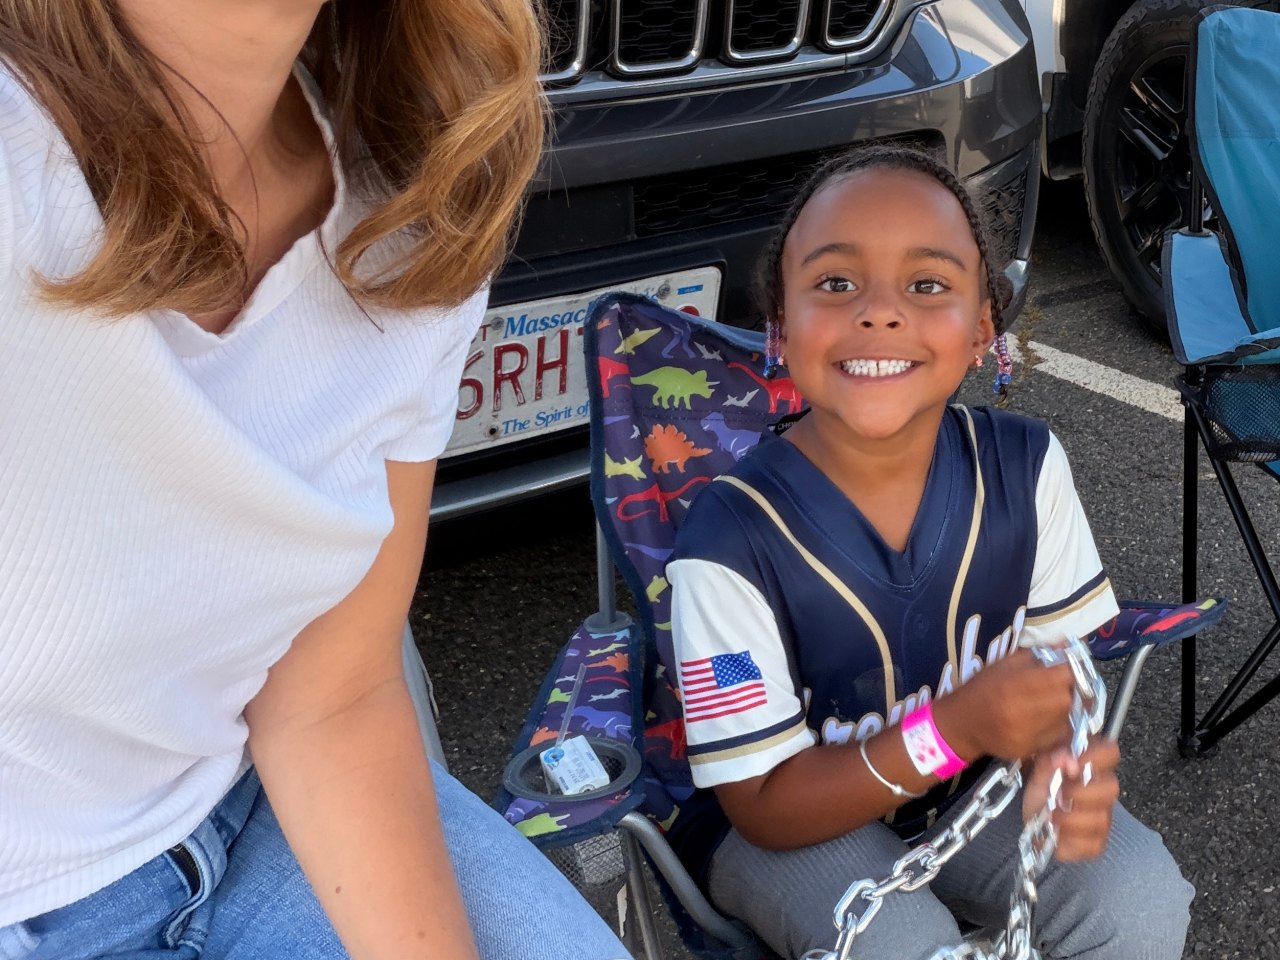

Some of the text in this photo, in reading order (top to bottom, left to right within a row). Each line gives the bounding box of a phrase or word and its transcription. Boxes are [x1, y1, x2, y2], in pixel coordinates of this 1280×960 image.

[503, 400, 591, 436] The Spirit of
